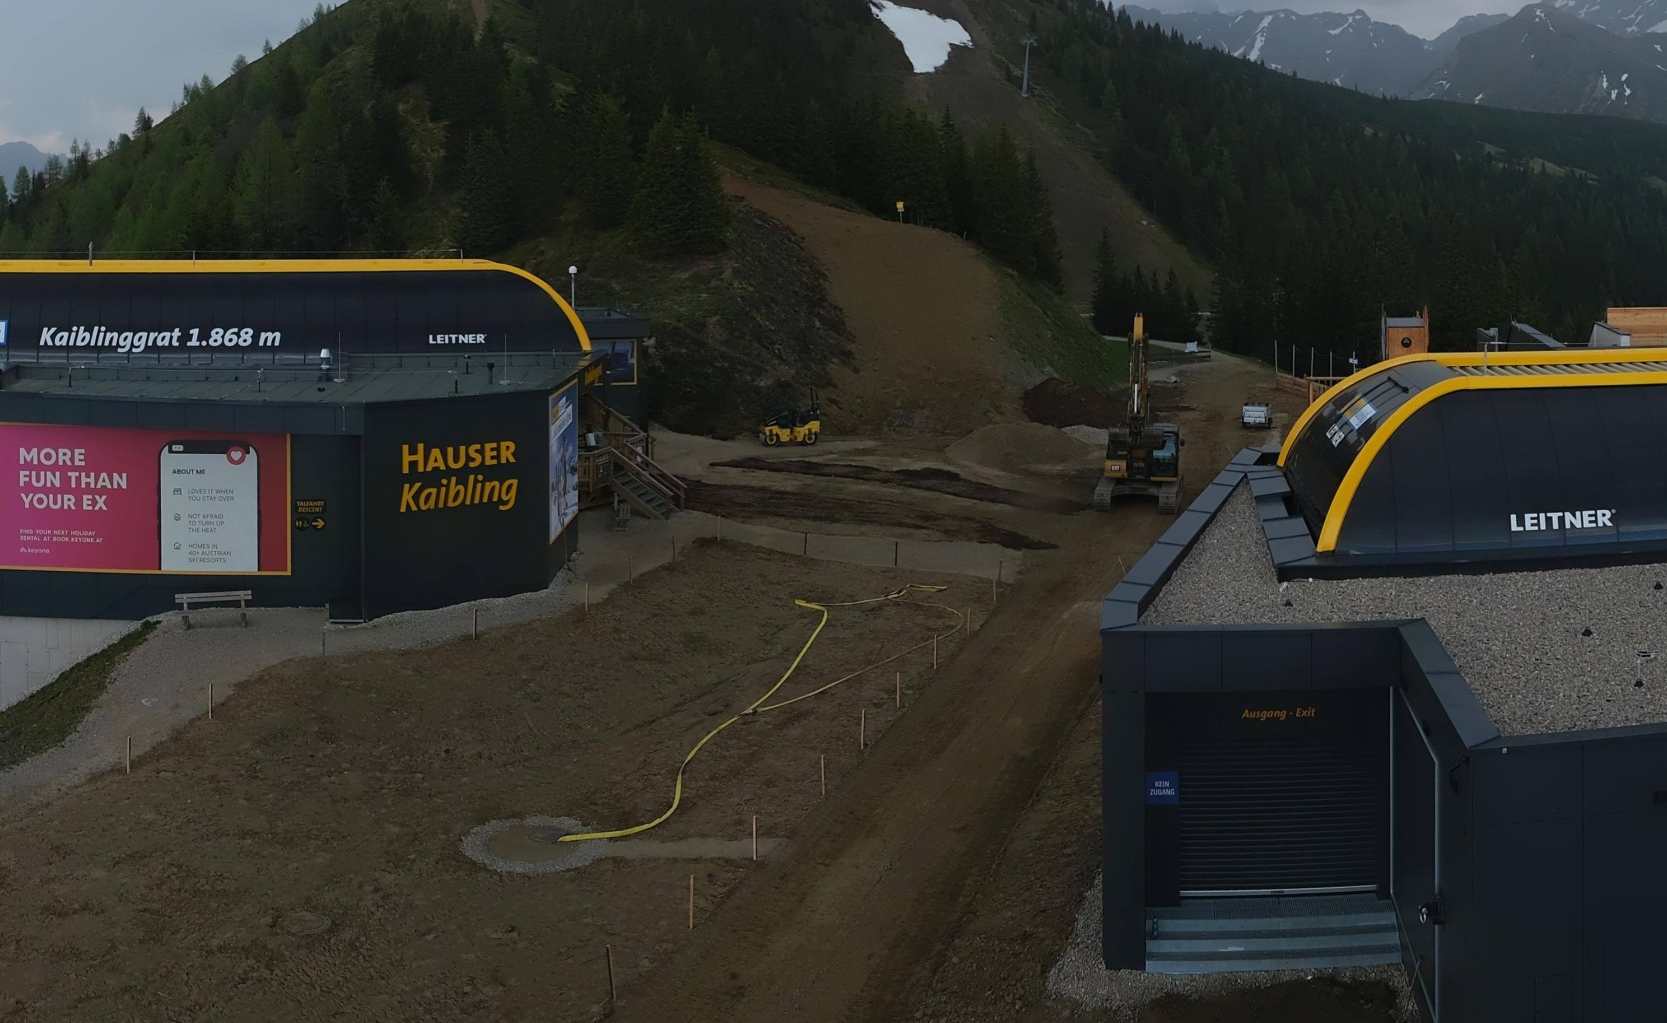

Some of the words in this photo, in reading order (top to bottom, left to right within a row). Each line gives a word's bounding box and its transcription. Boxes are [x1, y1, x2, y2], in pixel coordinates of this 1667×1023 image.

[39, 326, 181, 353] Kaiblinggrat
[186, 327, 253, 347] 1.868
[258, 331, 281, 346] m
[428, 333, 485, 344] LEITNER
[19, 447, 86, 466] MORE
[402, 441, 516, 474] HAUSER
[19, 470, 60, 488] FUN
[67, 472, 127, 489] THAN
[20, 493, 76, 510] YOUR
[82, 495, 108, 511] EX
[400, 475, 518, 512] Kaibling
[1510, 509, 1613, 532] LEITNER
[1242, 708, 1287, 721] Ausgang
[1295, 707, 1316, 718] Exit
[1149, 788, 1176, 797] ZUGANG
[1154, 780, 1171, 789] KEIN
